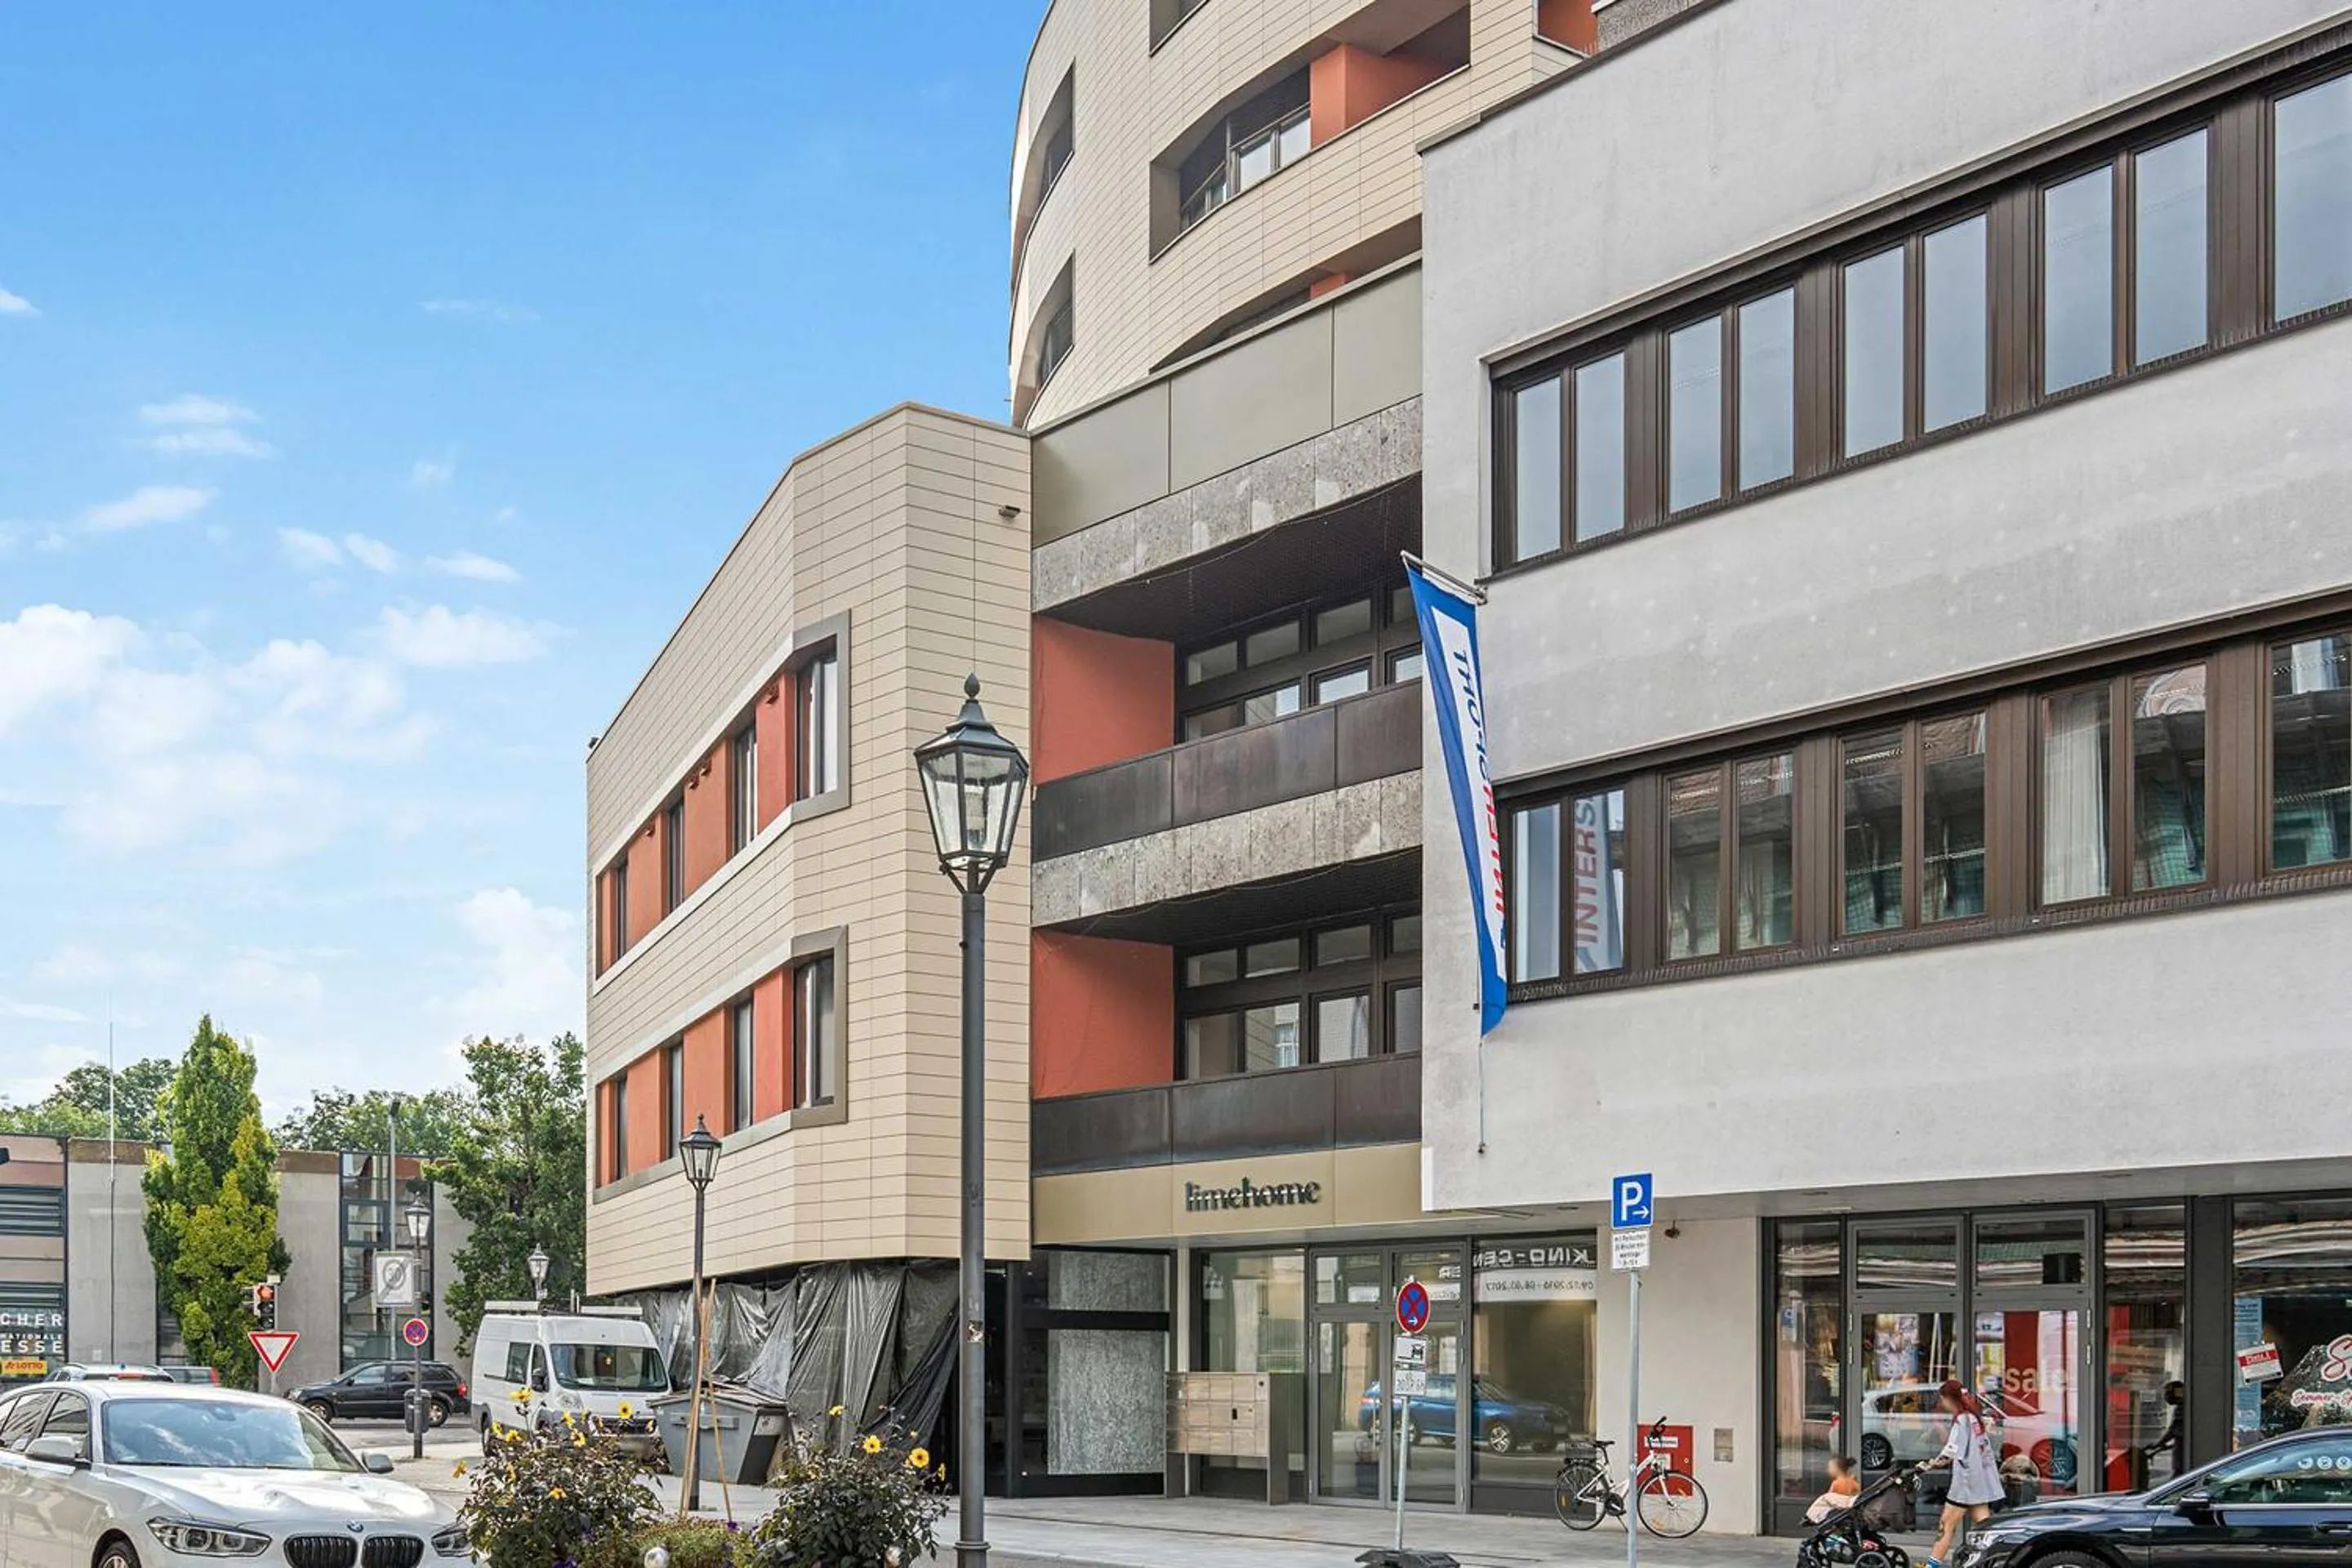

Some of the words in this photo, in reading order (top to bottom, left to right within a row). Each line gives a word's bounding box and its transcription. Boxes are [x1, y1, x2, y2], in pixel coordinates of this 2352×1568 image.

[1185, 1177, 1321, 1212] limehome
[1621, 1181, 1643, 1221] P
[0, 1312, 62, 1326] CHER
[1, 1339, 63, 1354] ESSE
